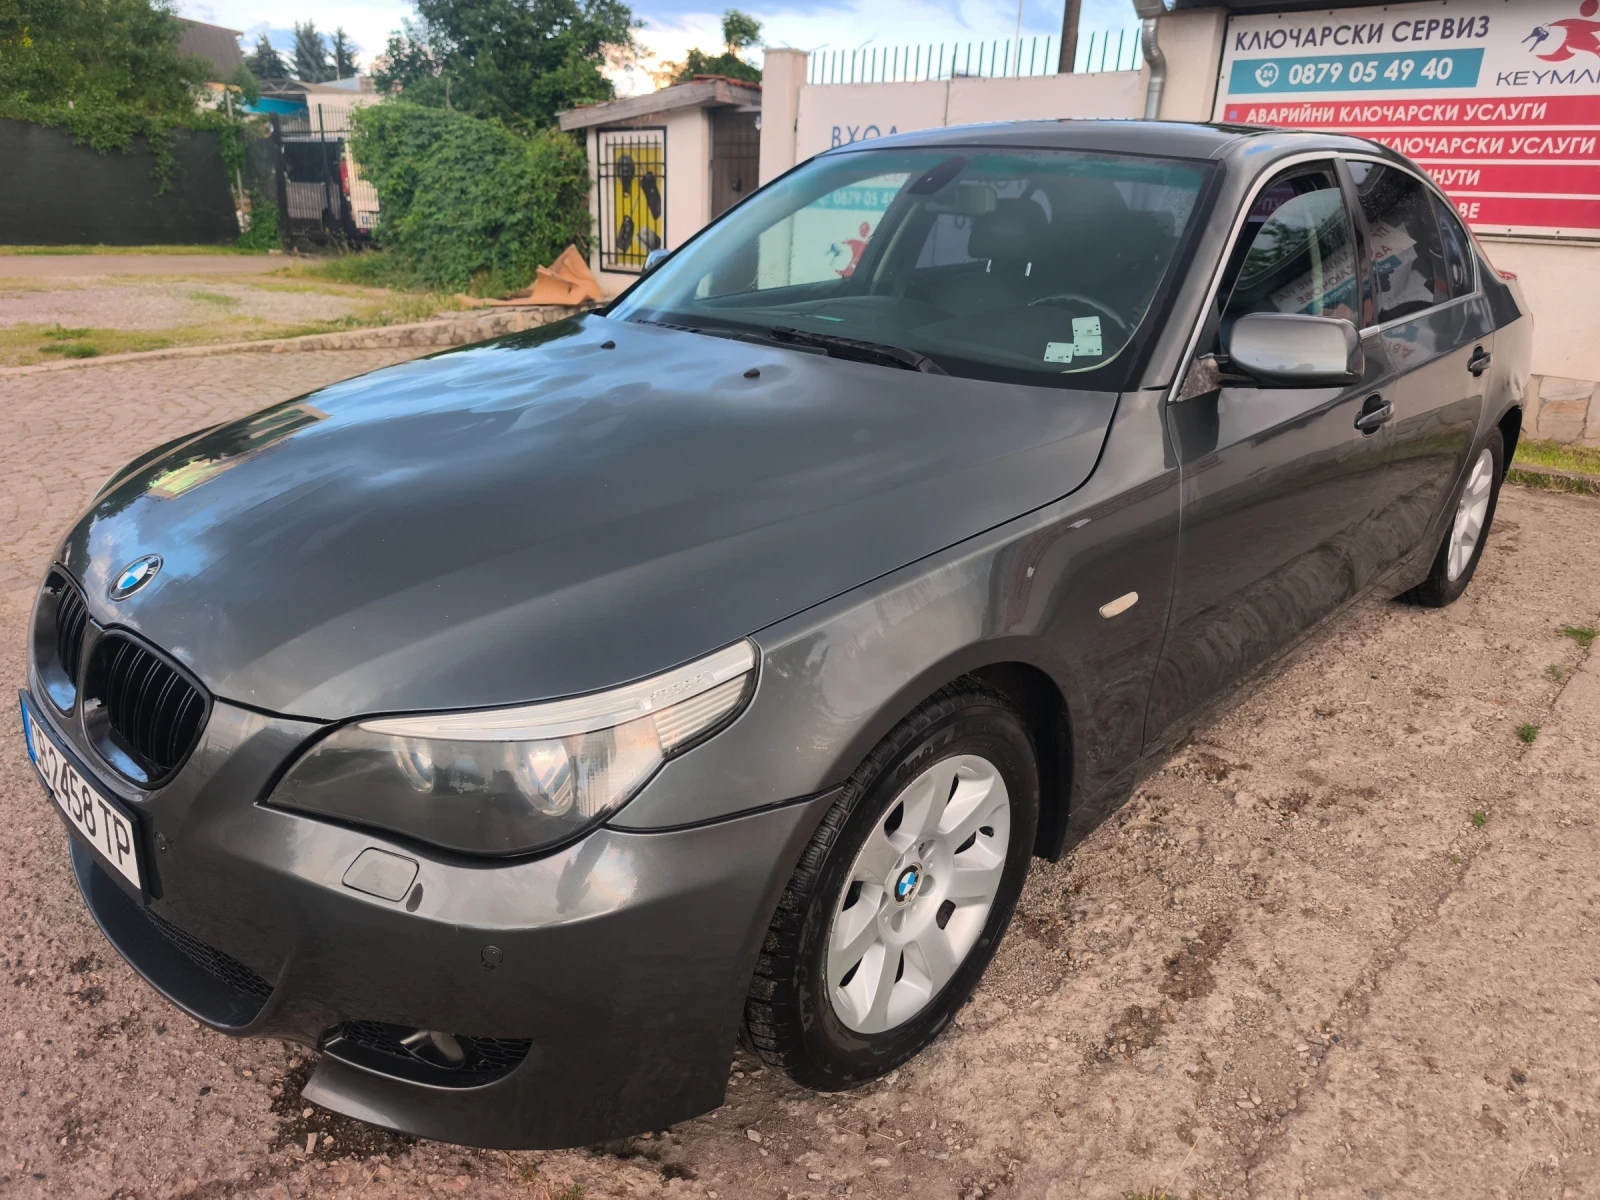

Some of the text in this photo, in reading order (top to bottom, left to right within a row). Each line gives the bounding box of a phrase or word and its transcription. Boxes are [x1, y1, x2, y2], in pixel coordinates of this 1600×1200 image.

[1234, 15, 1490, 51] КЛЮЧАРСКИ СЕРВИЗ
[1288, 57, 1453, 85] 0879 05 49 40
[1245, 102, 1547, 123] АВАРИЙНИ КЛЮЧАРСКИ УСЛУГИ
[1508, 136, 1596, 154] УСЛУГИ
